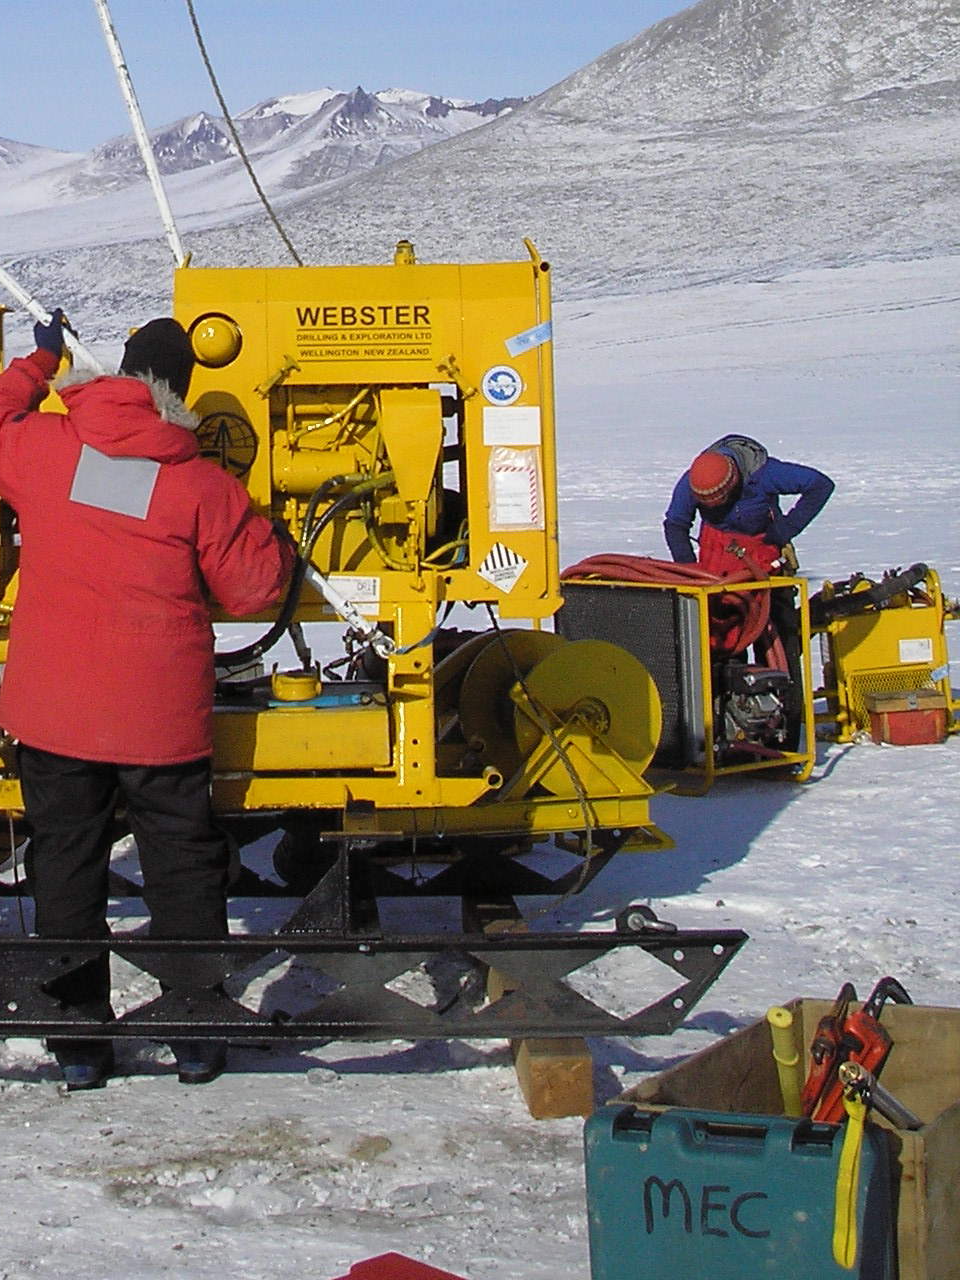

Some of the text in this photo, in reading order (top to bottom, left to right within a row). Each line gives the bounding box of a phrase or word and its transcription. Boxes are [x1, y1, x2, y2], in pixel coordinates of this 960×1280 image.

[296, 305, 431, 326] WEBSTER
[296, 332, 432, 342] DRILLING & EXPLORATION LTD
[300, 348, 430, 357] WELLINGTON NEW ZEALAND
[643, 1174, 771, 1239] MEC
